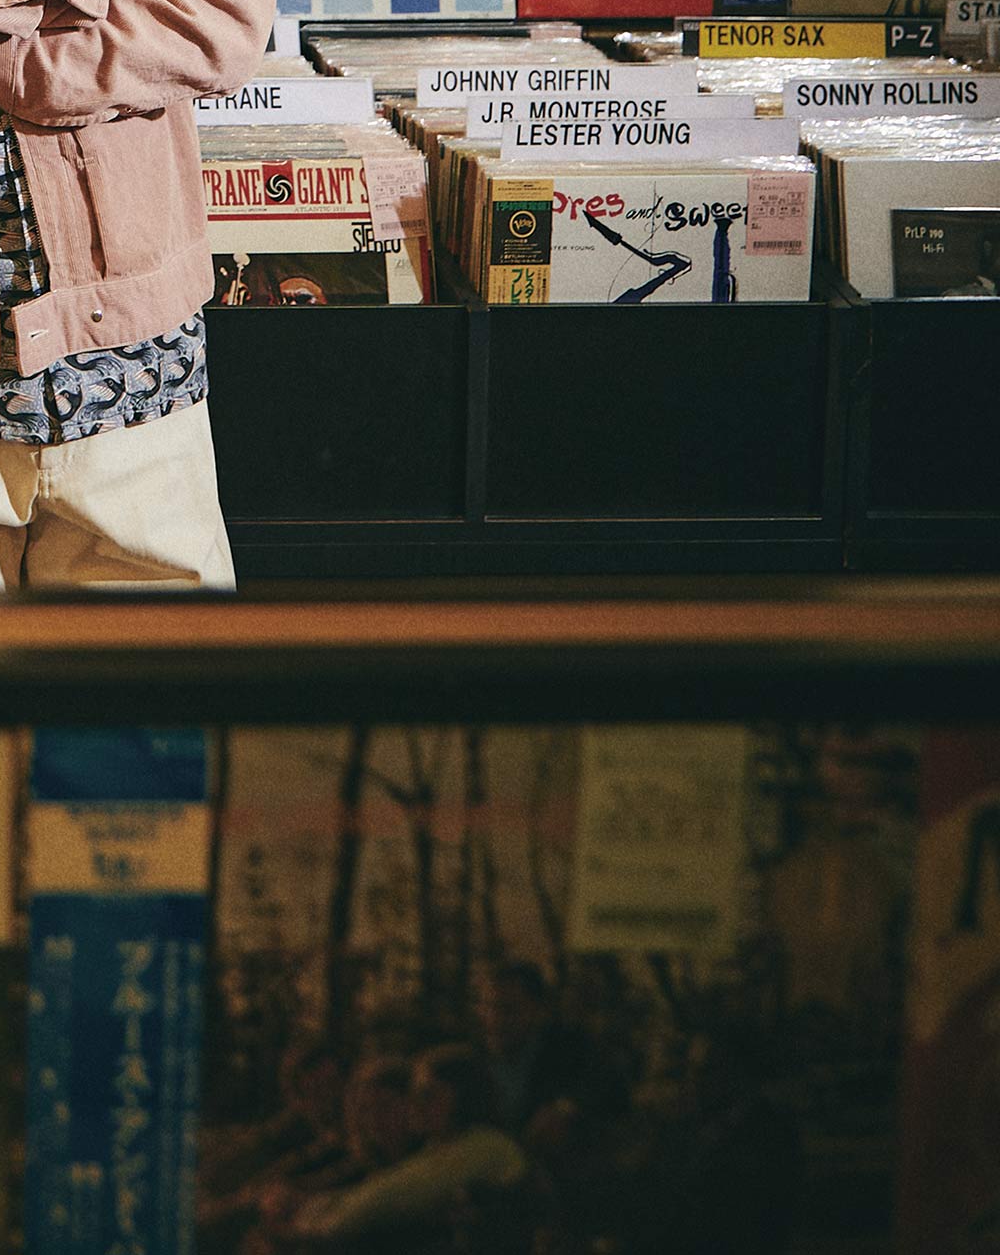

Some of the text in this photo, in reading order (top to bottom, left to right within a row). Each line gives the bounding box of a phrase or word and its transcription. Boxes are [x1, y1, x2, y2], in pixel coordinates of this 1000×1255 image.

[704, 25, 825, 47] TENOR SAX
[891, 25, 934, 48] P-Z
[430, 69, 611, 92] JOHNNY GRIFFIN
[193, 86, 283, 110] LRANE
[796, 81, 979, 106] SONNY ROLLINS
[529, 100, 668, 121] MONTEROSE
[516, 122, 691, 146] LESTER YOUNG
[296, 166, 355, 205] GIANT
